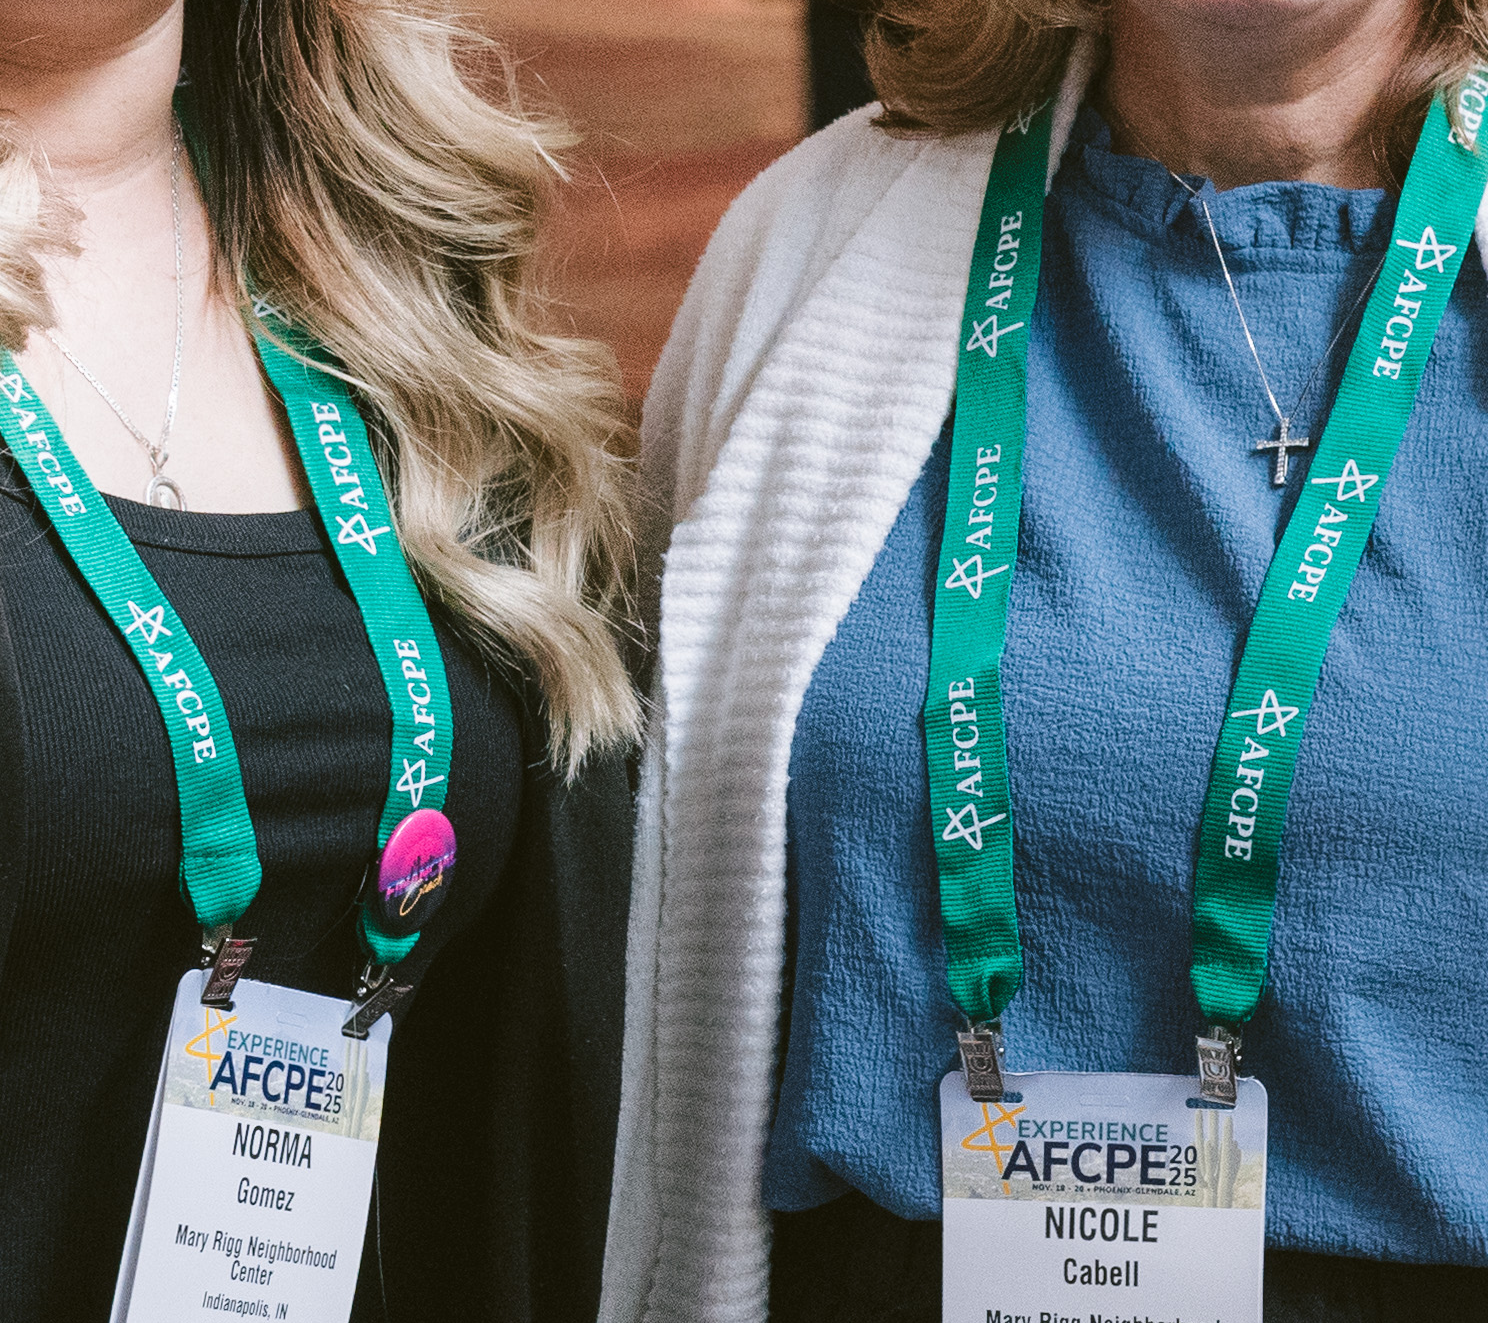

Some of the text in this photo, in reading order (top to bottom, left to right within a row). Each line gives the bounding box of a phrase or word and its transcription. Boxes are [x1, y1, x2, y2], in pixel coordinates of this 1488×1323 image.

[988, 210, 1023, 311] AFCPE
[1372, 268, 1428, 381] AFCPE
[11, 406, 88, 520] AFCPE
[311, 401, 370, 512] AFCPE
[966, 443, 1002, 550] AFCPE
[1287, 502, 1349, 603] AFCPE
[148, 647, 218, 764] AFCPE
[393, 638, 436, 757] AFCPE
[948, 676, 984, 799] AFCPE
[1224, 736, 1270, 862] AFCPE
[227, 1029, 329, 1068] EXPERIENCE
[209, 1050, 345, 1111] AFCPE 20
[324, 1093, 343, 1114] 25
[232, 1122, 313, 1169] NORMA
[1017, 1119, 1168, 1143] EXPERIENCE
[1001, 1140, 1198, 1186] AFCPE 20
[1168, 1167, 1198, 1187] 25
[237, 1177, 295, 1212] Gomez
[175, 1224, 338, 1270] Mary Rigg Neighborhood
[1045, 1206, 1159, 1243] NICOLE
[230, 1260, 274, 1286] Center
[1063, 1257, 1139, 1287] Cabell
[202, 1291, 289, 1321] Indianapolis, IN
